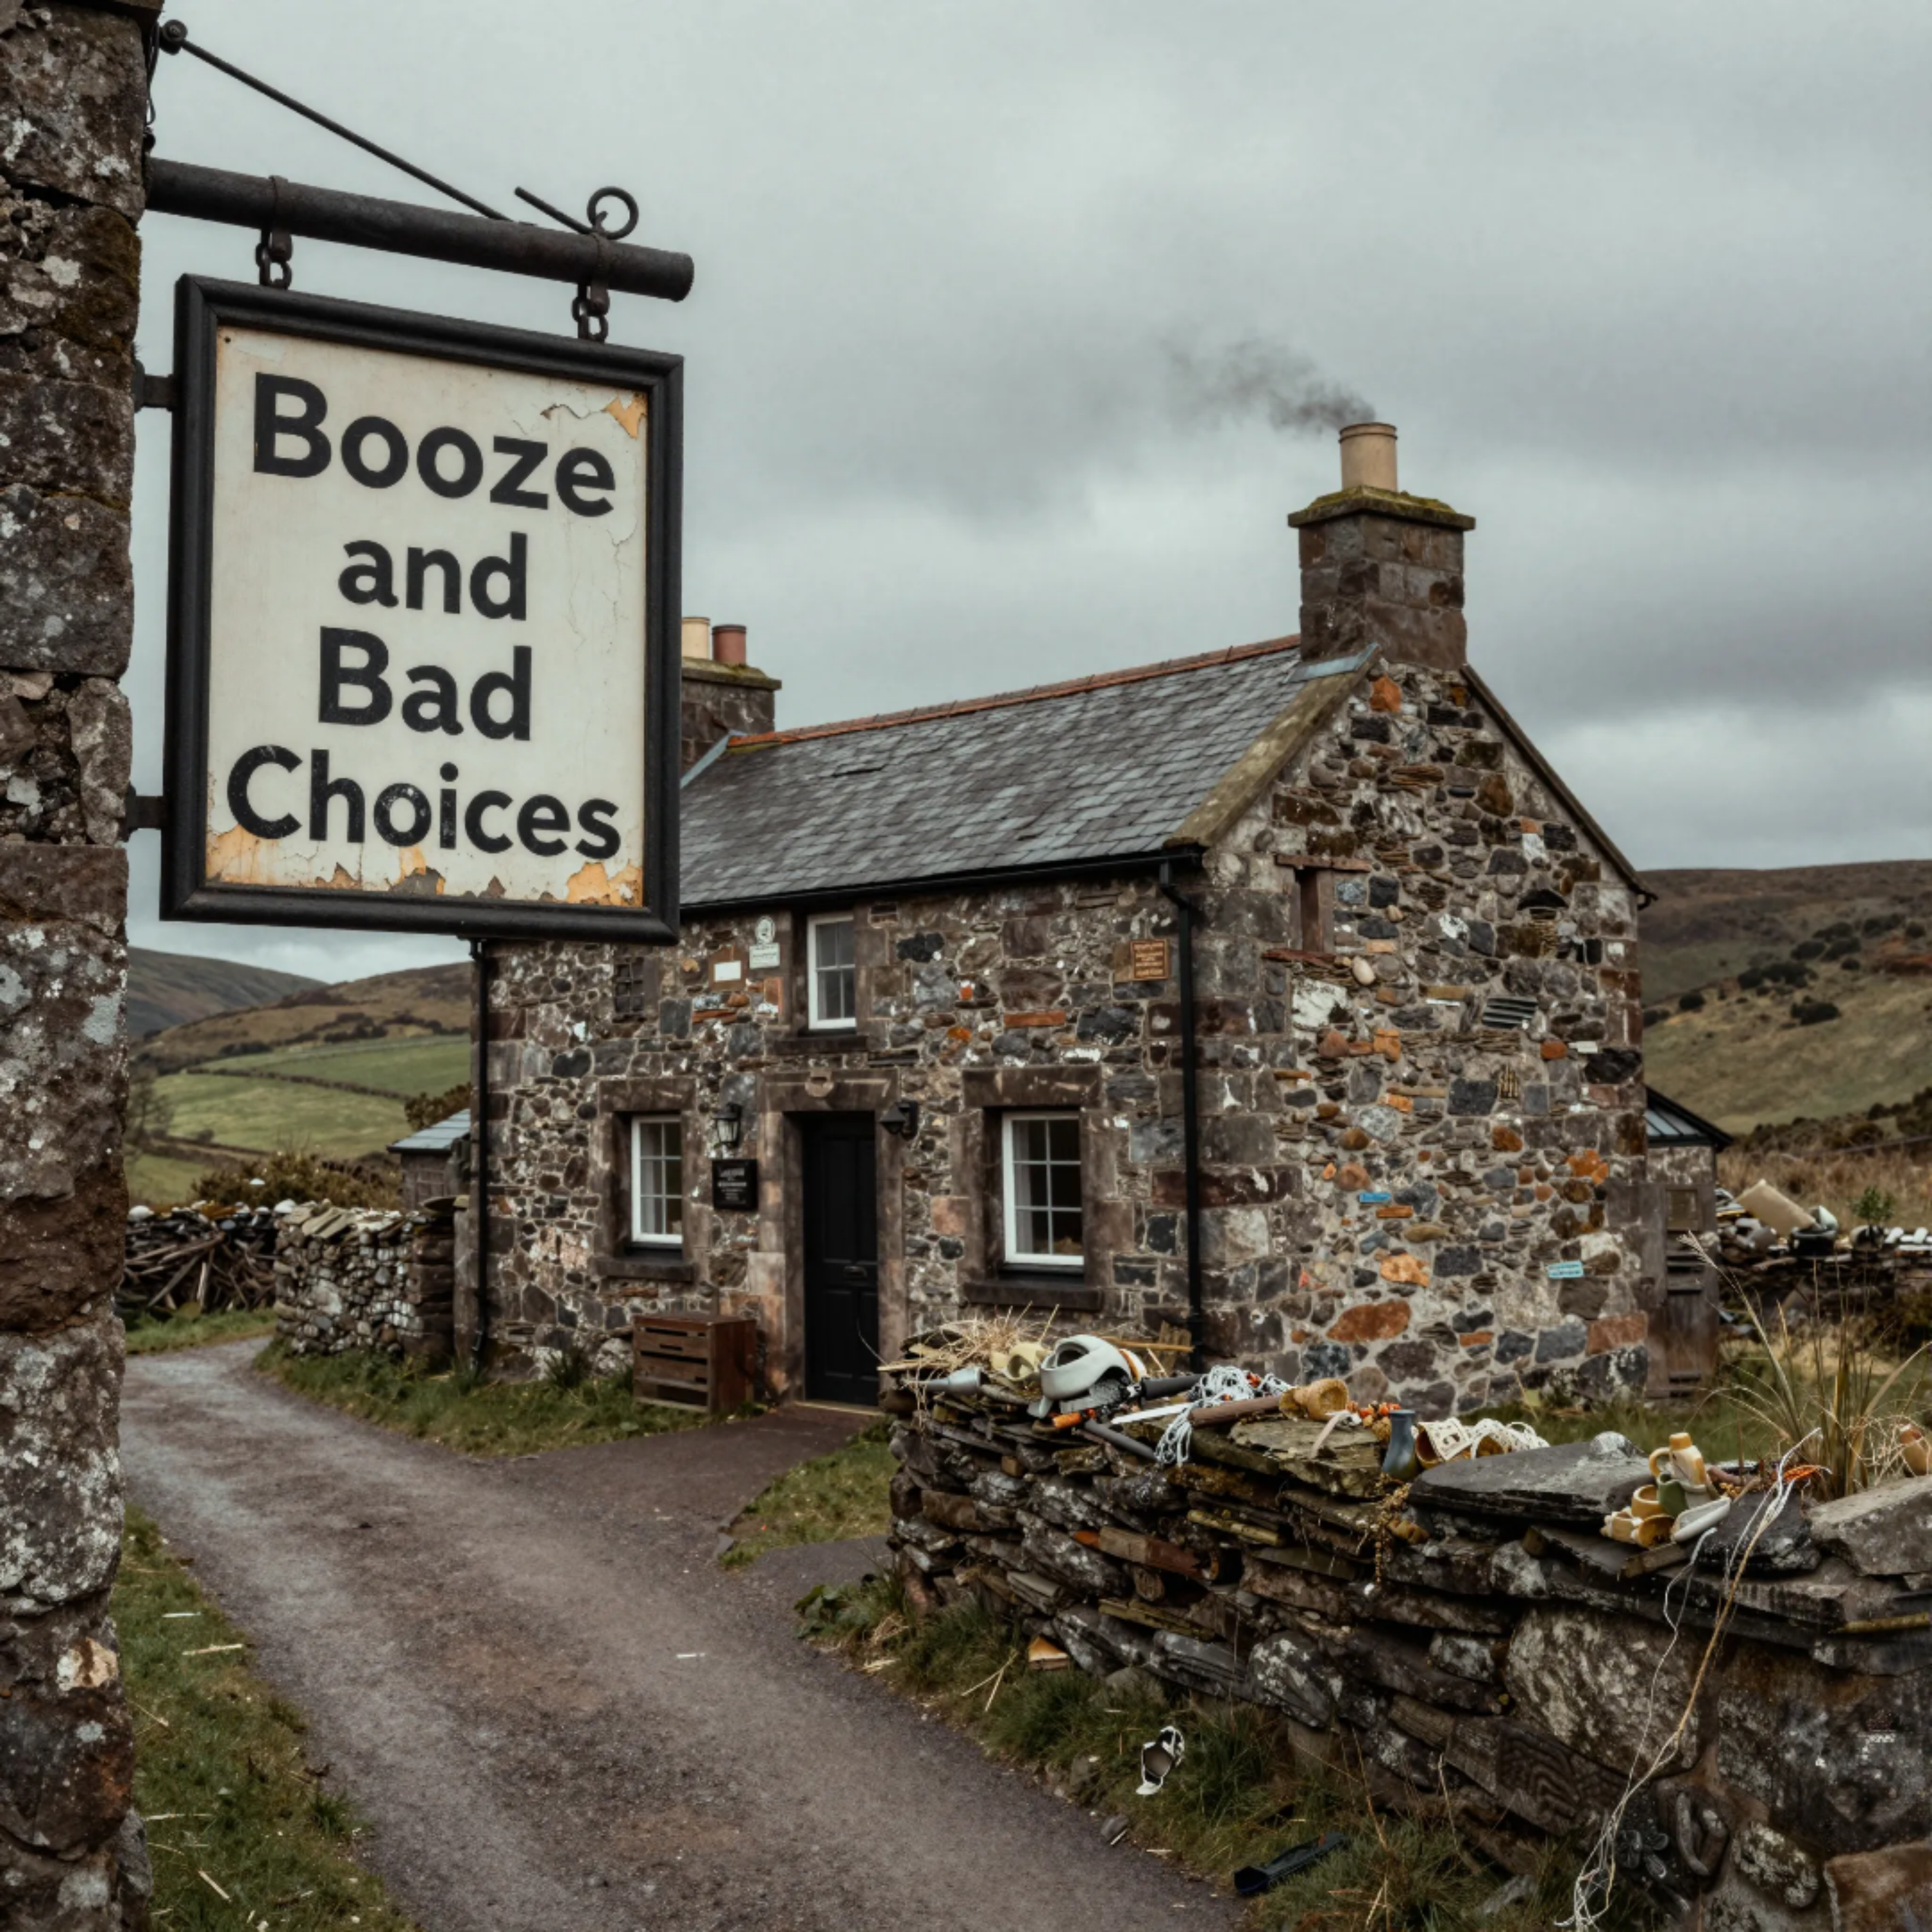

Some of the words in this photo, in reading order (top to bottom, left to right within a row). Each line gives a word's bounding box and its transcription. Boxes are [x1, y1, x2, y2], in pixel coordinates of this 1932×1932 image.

[253, 372, 616, 517] Booze
[338, 531, 528, 621] and
[318, 626, 533, 741] Bad
[227, 745, 621, 860] Choices
